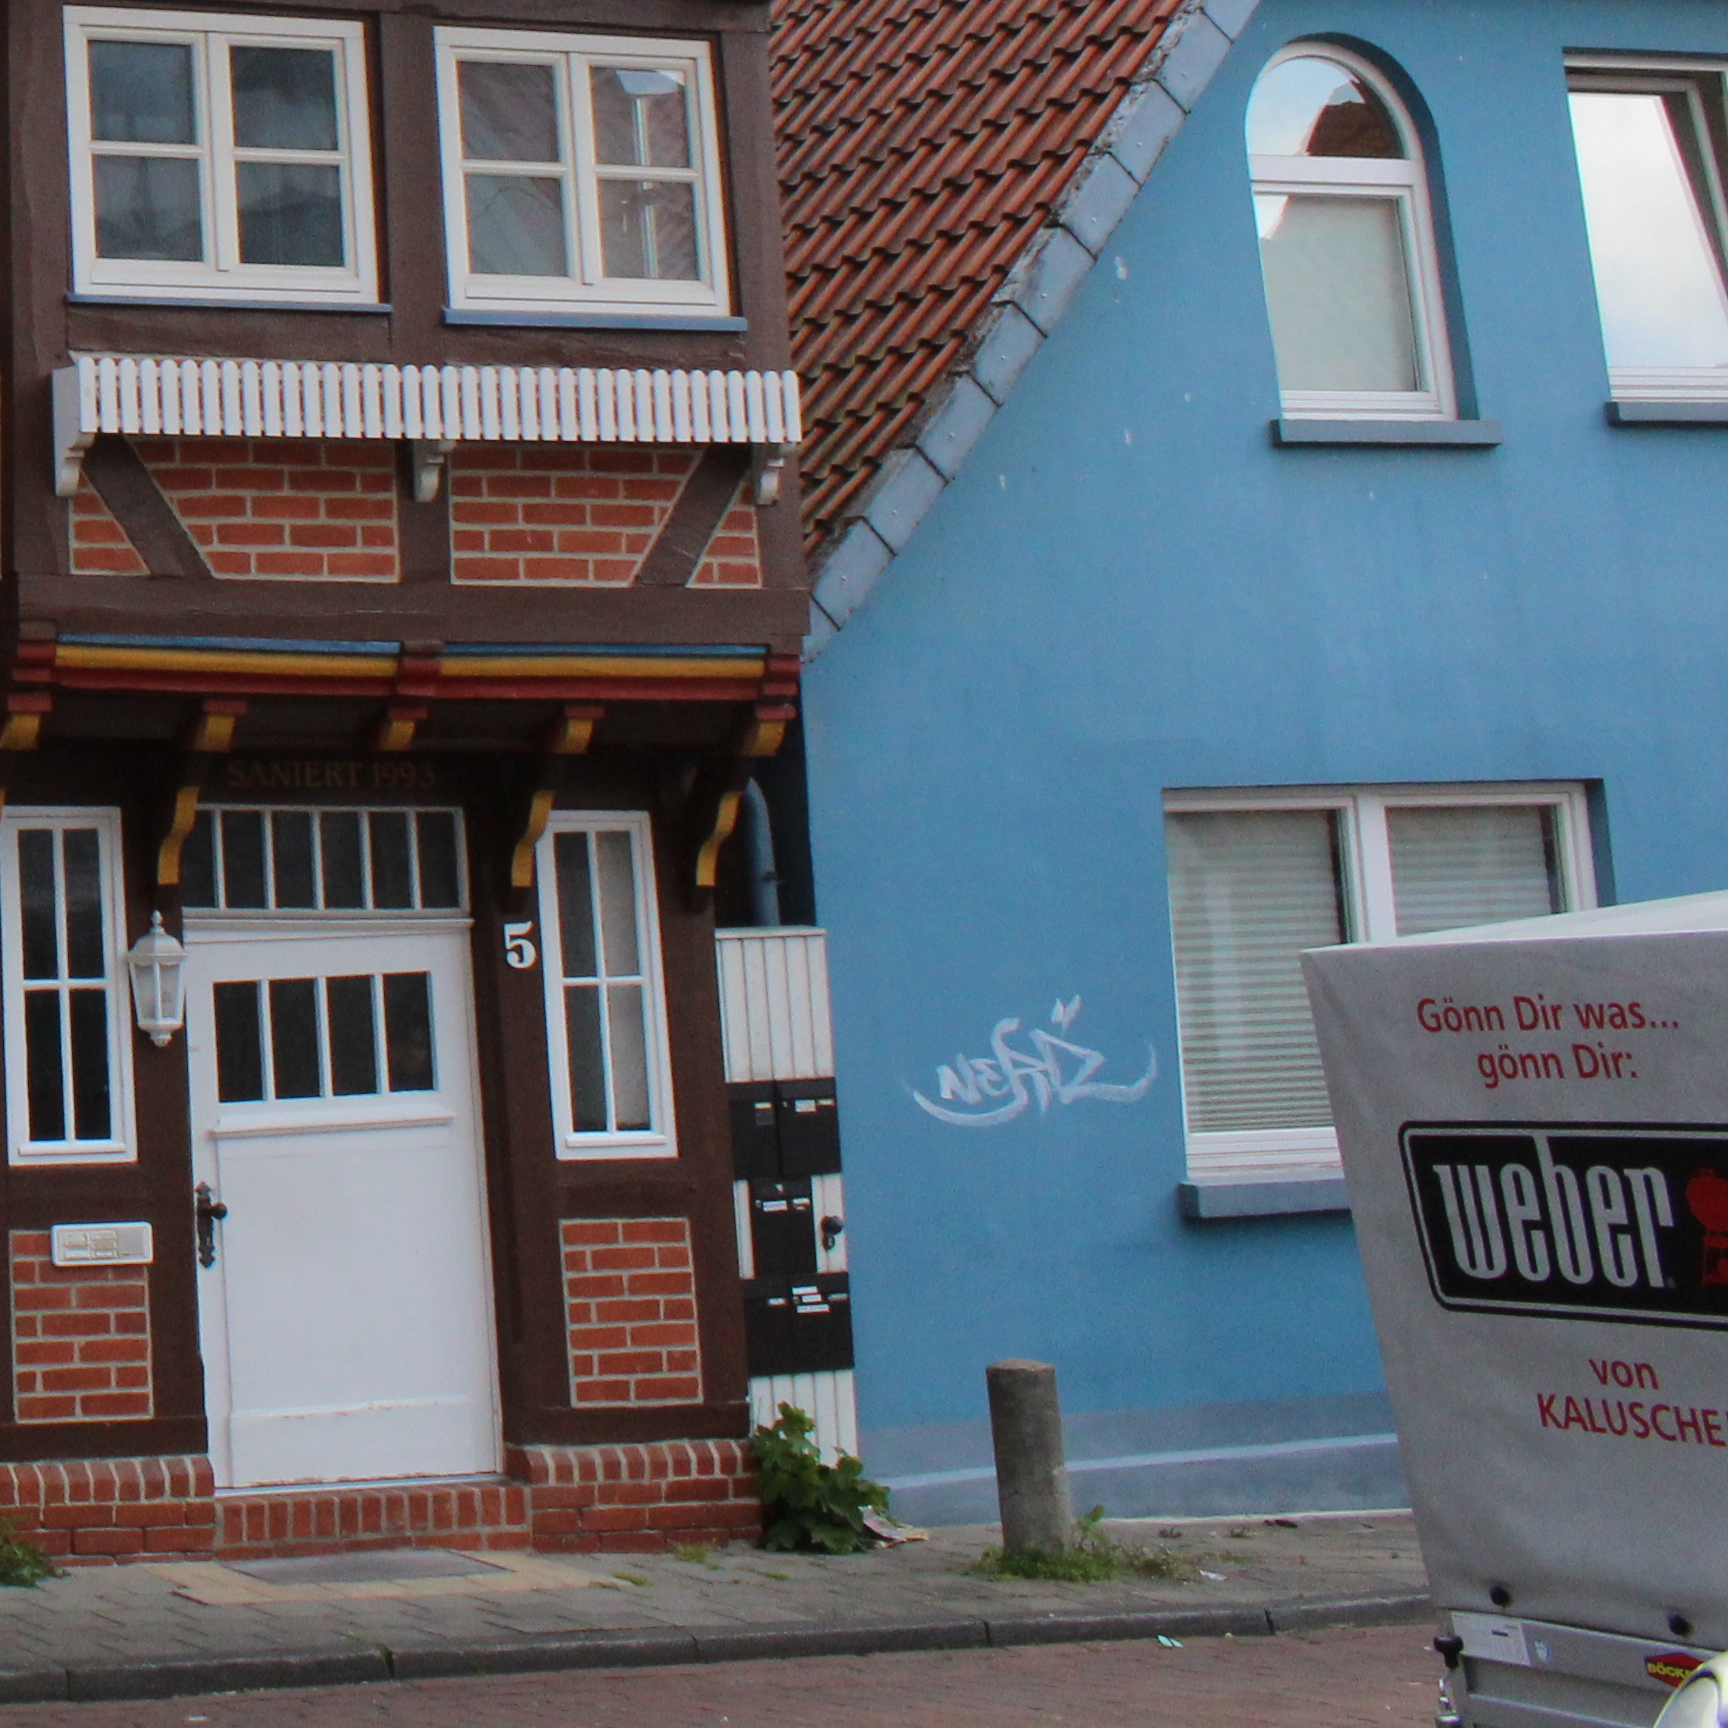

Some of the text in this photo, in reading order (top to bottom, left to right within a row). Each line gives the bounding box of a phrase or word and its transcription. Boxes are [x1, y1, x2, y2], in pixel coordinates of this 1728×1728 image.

[227, 759, 362, 788] SANIERT
[503, 920, 537, 969] 5
[1416, 993, 1680, 1033] Gönn Dir was...
[1476, 1041, 1639, 1090] gönn Dir:
[1432, 1136, 1675, 1288] weber
[1588, 1357, 1660, 1390] von
[1536, 1392, 1728, 1448] KALUSCHE
